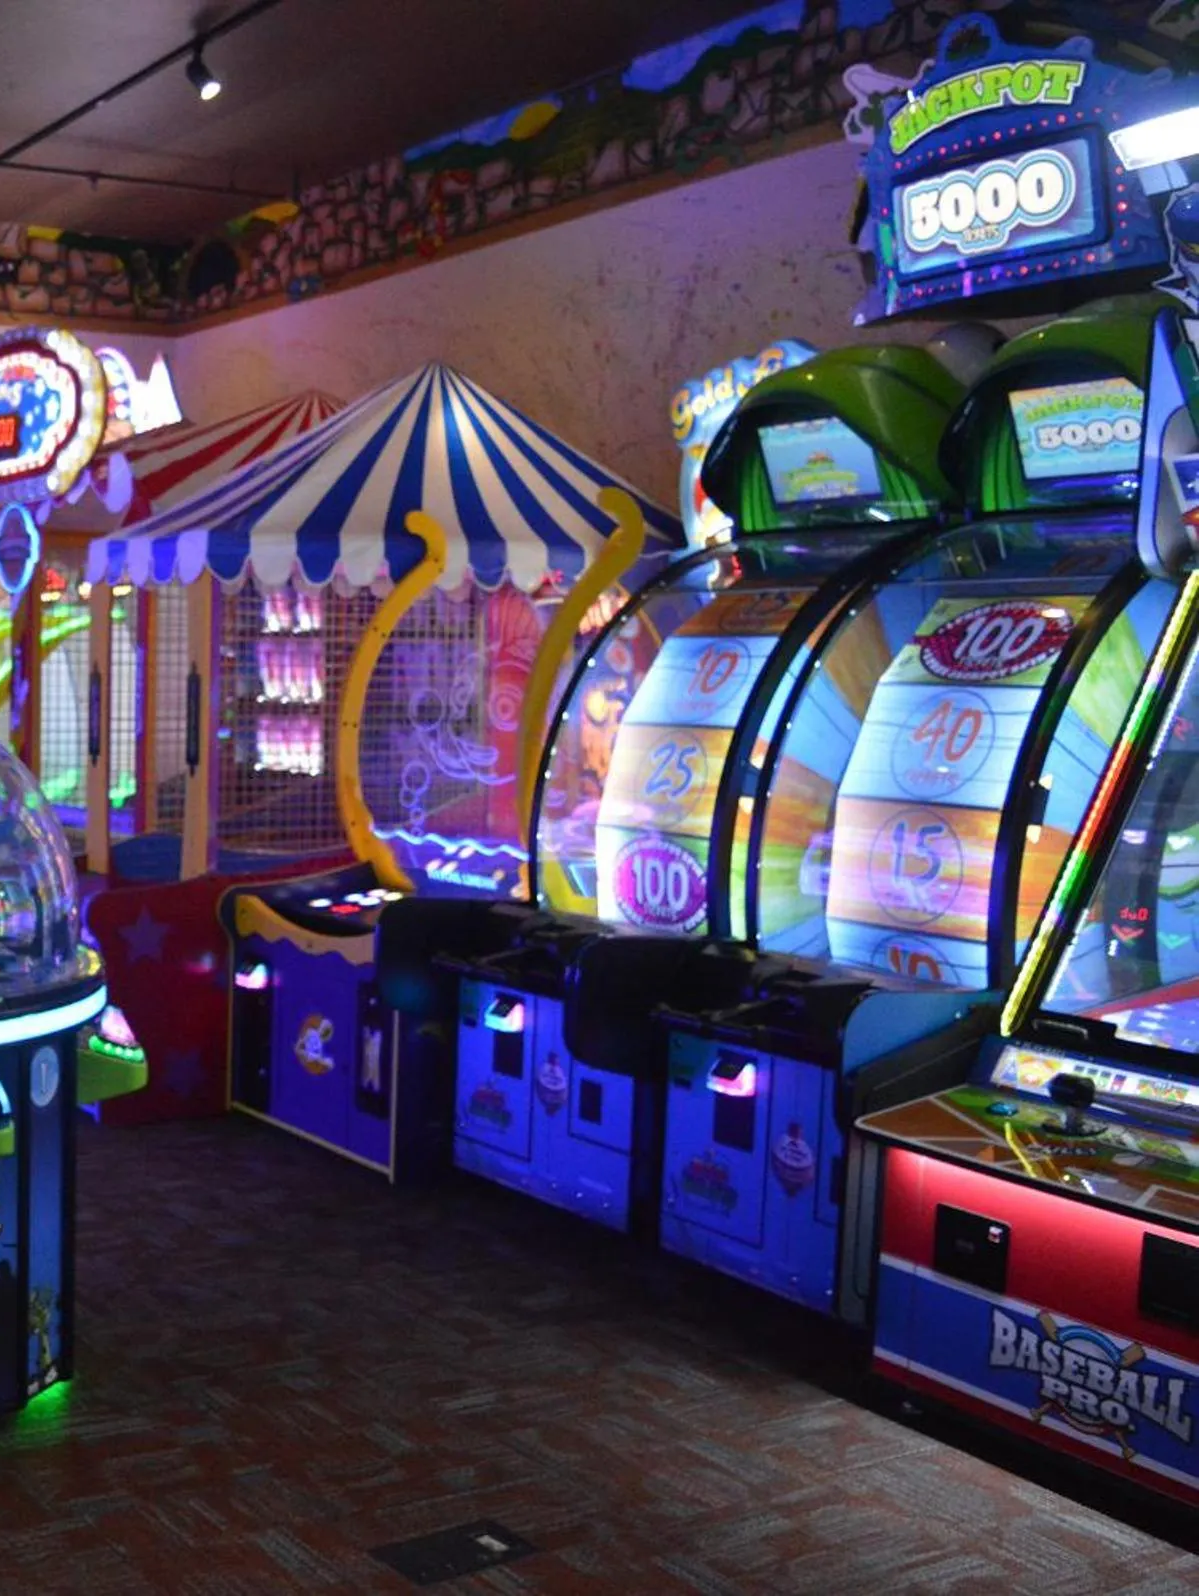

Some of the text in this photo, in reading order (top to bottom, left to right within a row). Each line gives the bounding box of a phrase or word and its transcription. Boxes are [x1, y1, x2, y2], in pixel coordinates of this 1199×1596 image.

[890, 61, 1084, 152] JACKPOT
[910, 161, 1065, 240] 5000
[1039, 417, 1142, 449] 5000
[952, 615, 1045, 660] 100
[688, 645, 739, 696] 10
[913, 698, 983, 763] 40
[645, 742, 697, 798] 25
[632, 853, 689, 911] 100
[892, 821, 944, 886] 15
[989, 1308, 1192, 1442] BASEBALL
[1040, 1374, 1130, 1426] PRO
